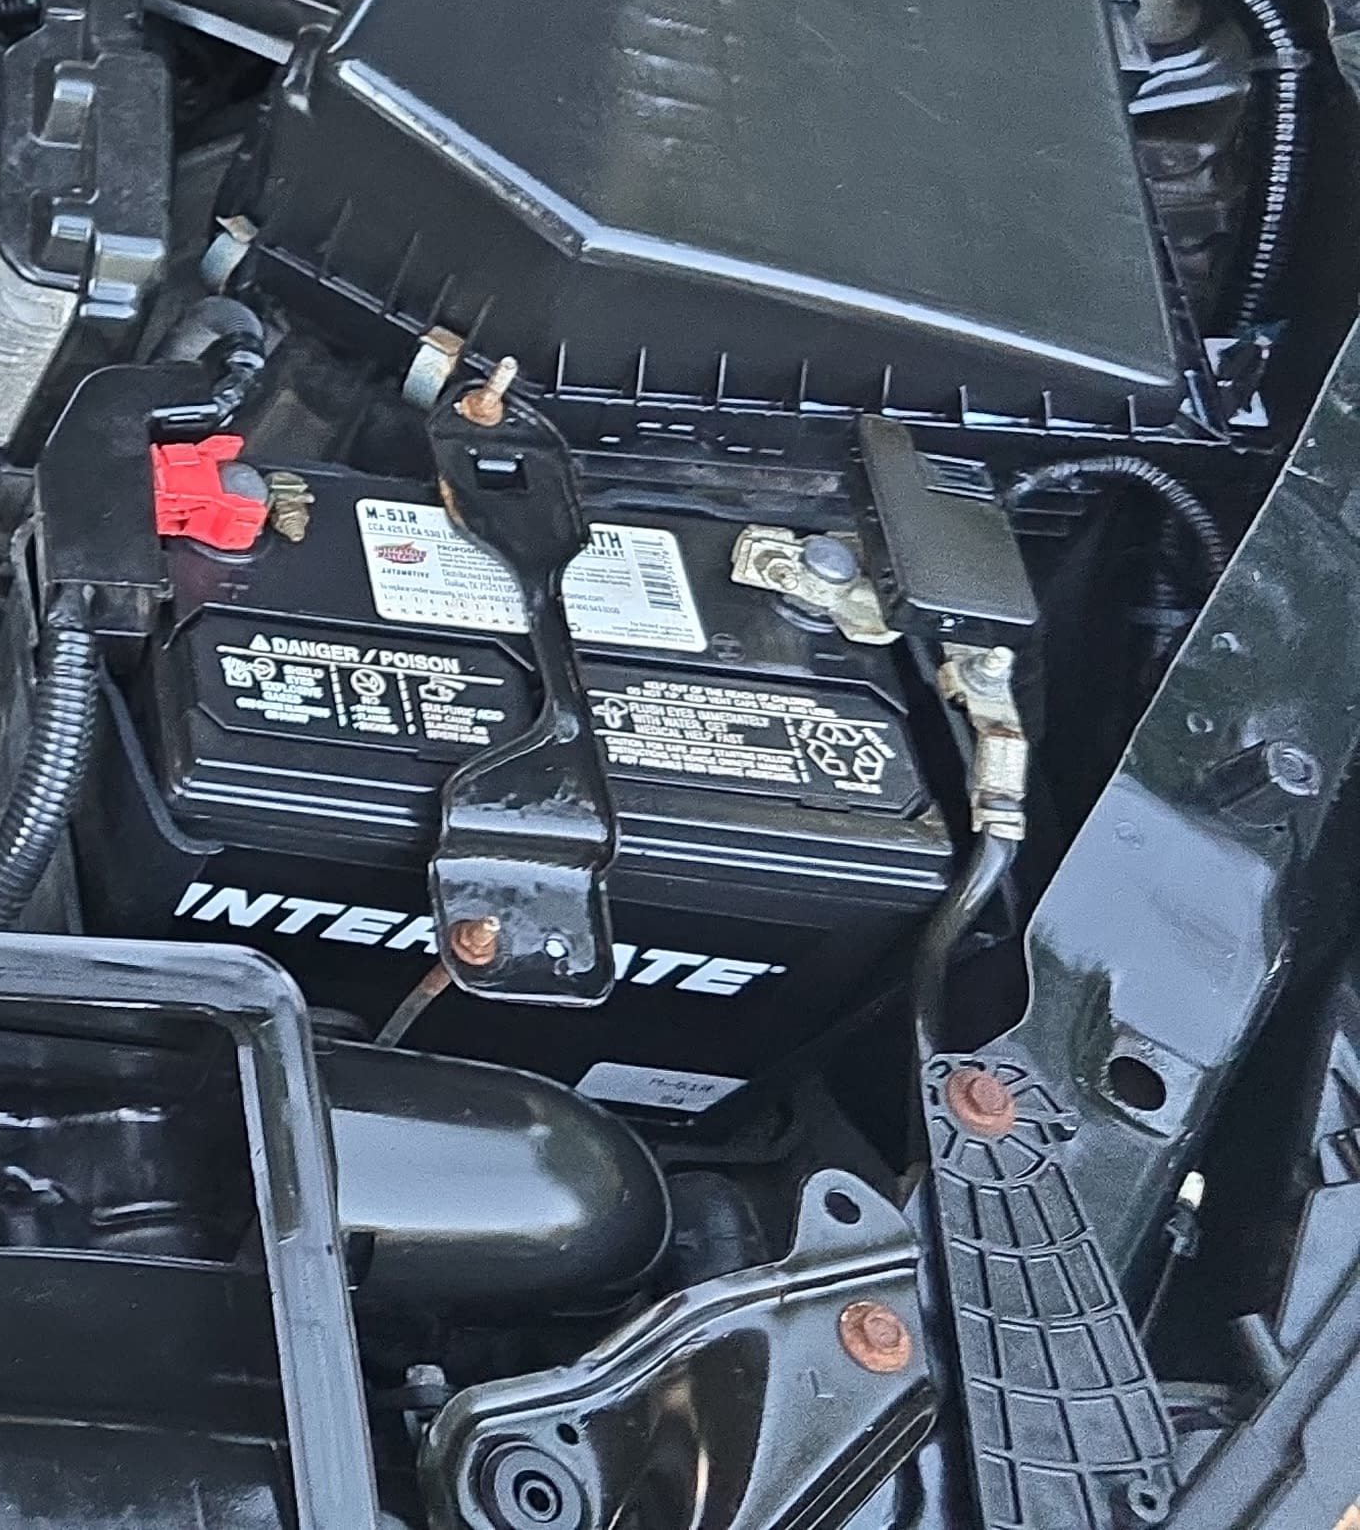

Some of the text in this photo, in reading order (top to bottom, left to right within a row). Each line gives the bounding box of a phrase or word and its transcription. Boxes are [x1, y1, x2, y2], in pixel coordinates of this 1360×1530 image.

[365, 506, 418, 525] M-51R
[270, 636, 360, 664] DANGER
[379, 650, 461, 674] POISON
[629, 702, 770, 728] FLUSH EYES IMMEDIATELY
[631, 713, 662, 726] WITH
[704, 720, 728, 733] GET
[634, 724, 745, 745] MEDICAL HELP FAST
